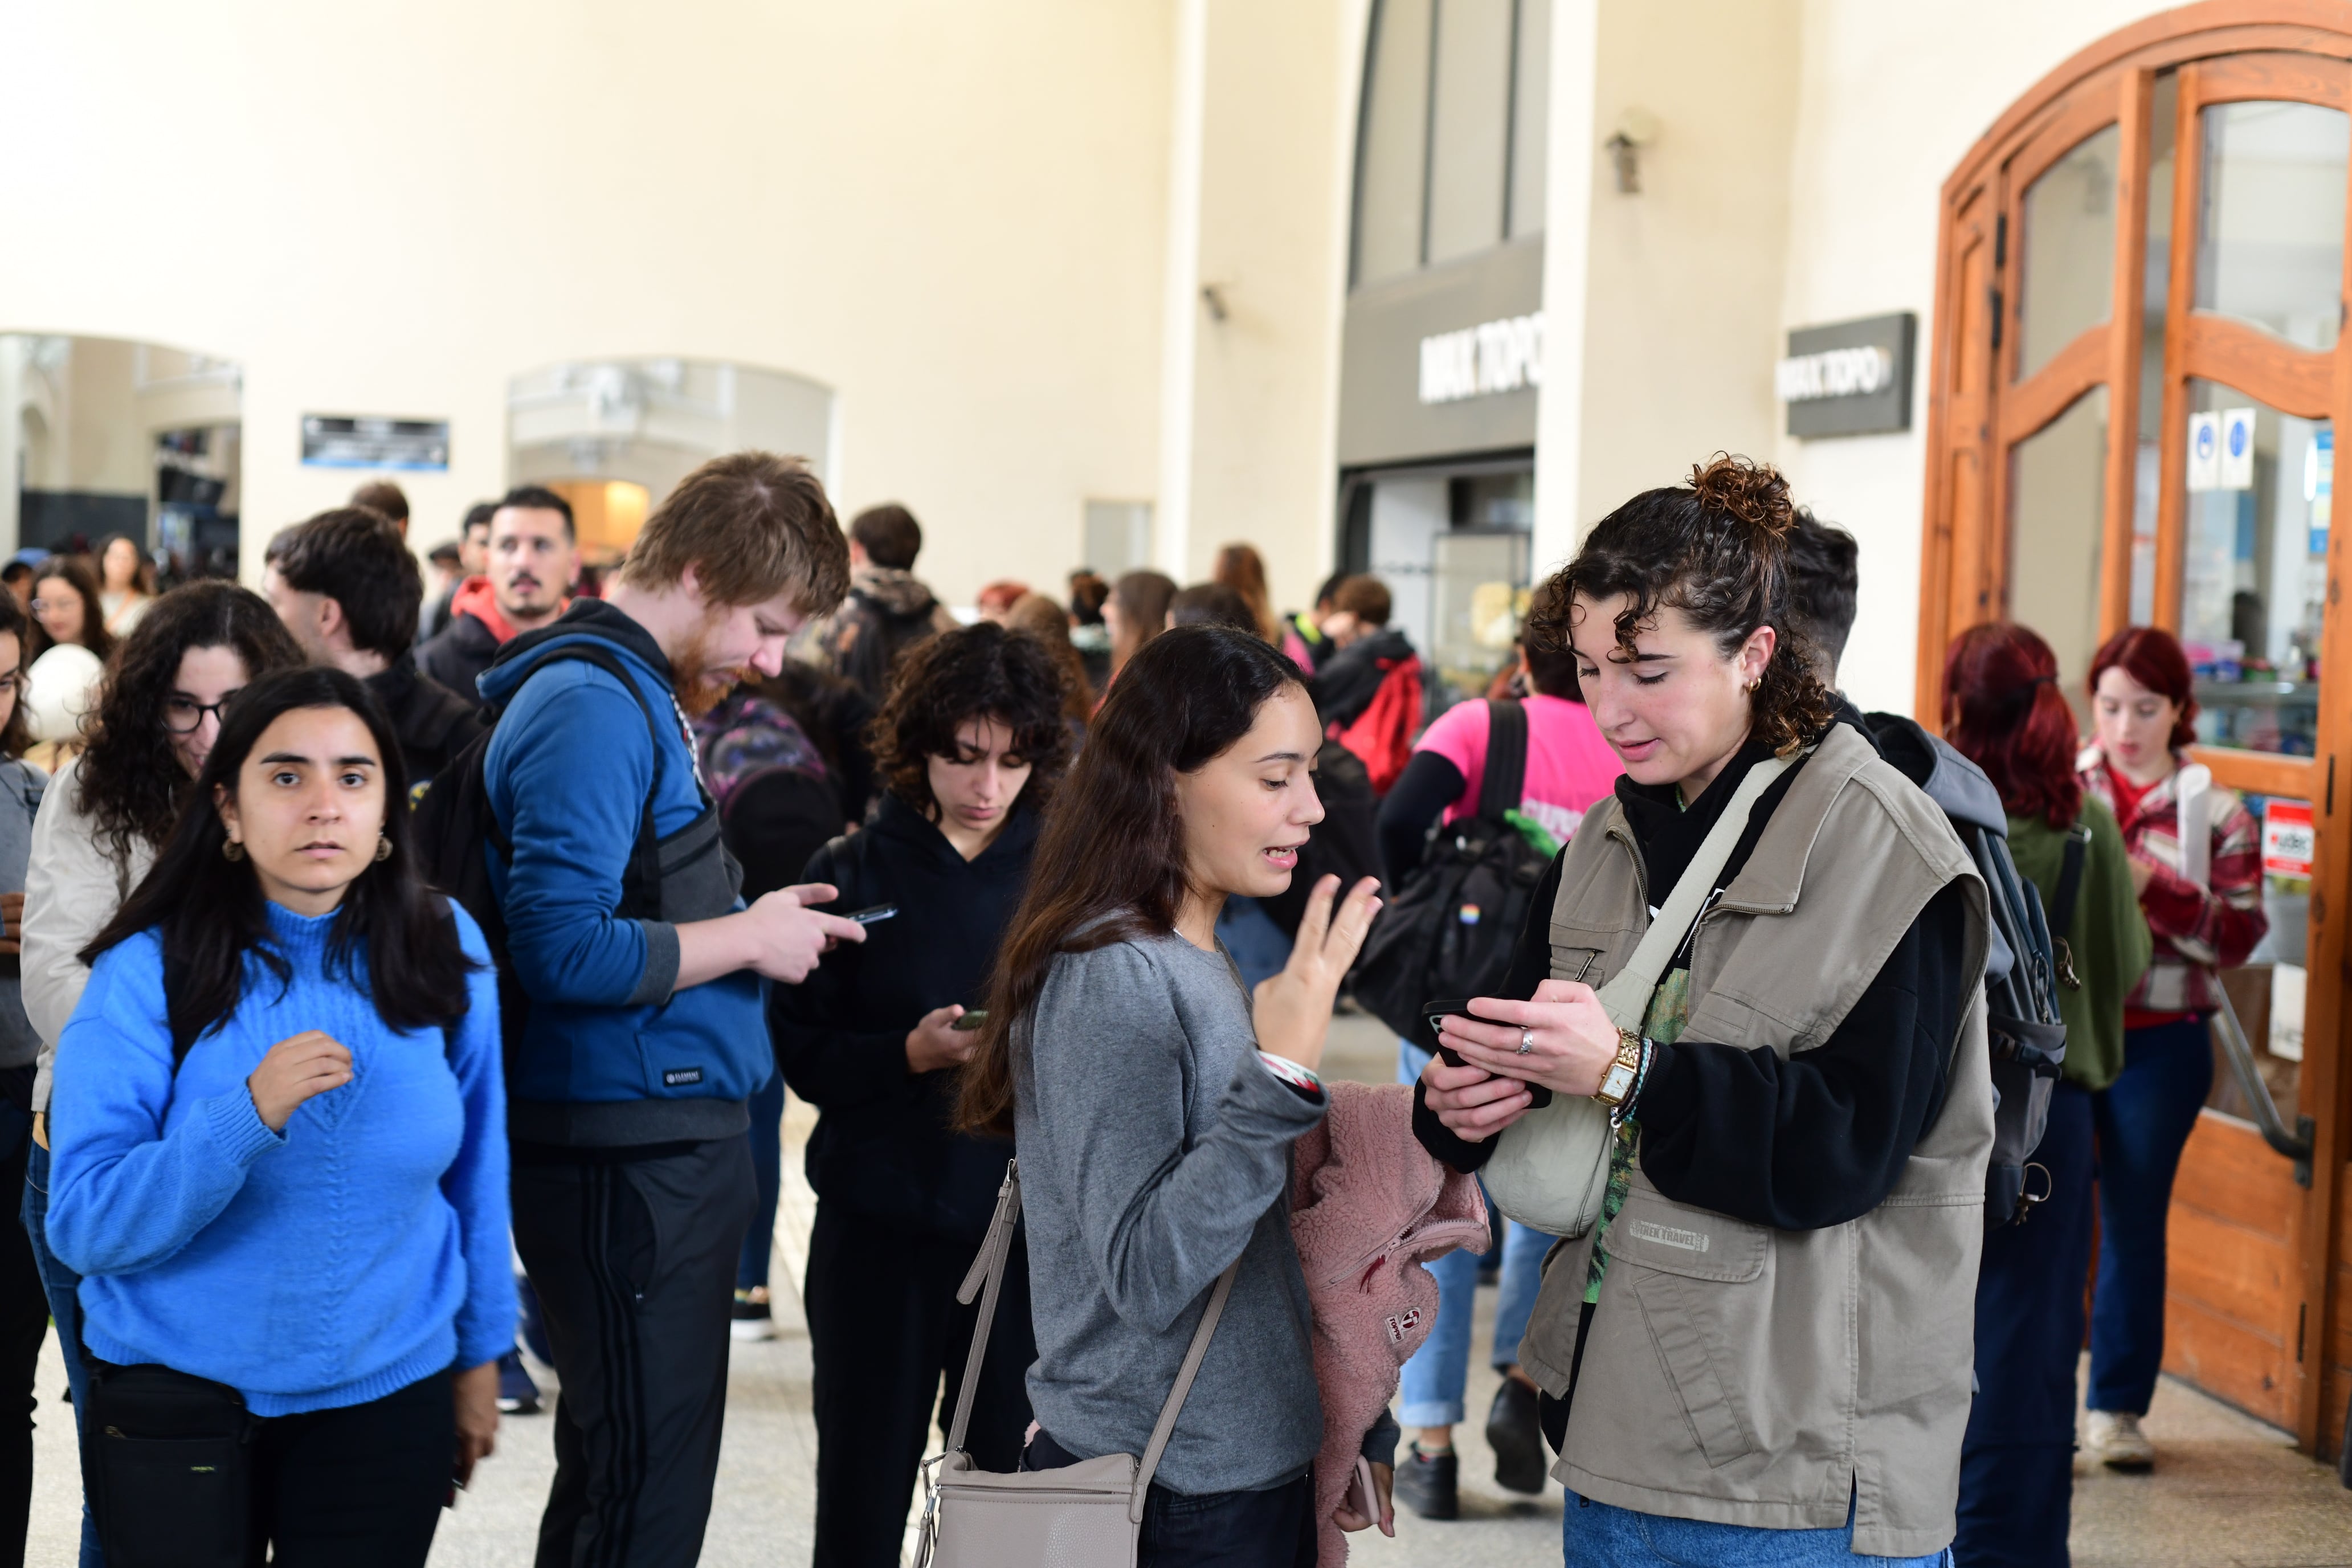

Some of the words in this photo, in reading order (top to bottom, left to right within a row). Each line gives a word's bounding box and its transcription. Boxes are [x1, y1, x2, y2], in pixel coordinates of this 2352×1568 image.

[1640, 1225, 1660, 1239] TREK
[1661, 1229, 1694, 1246] TRAVEL
[1389, 1317, 1402, 1341] TOPPER
